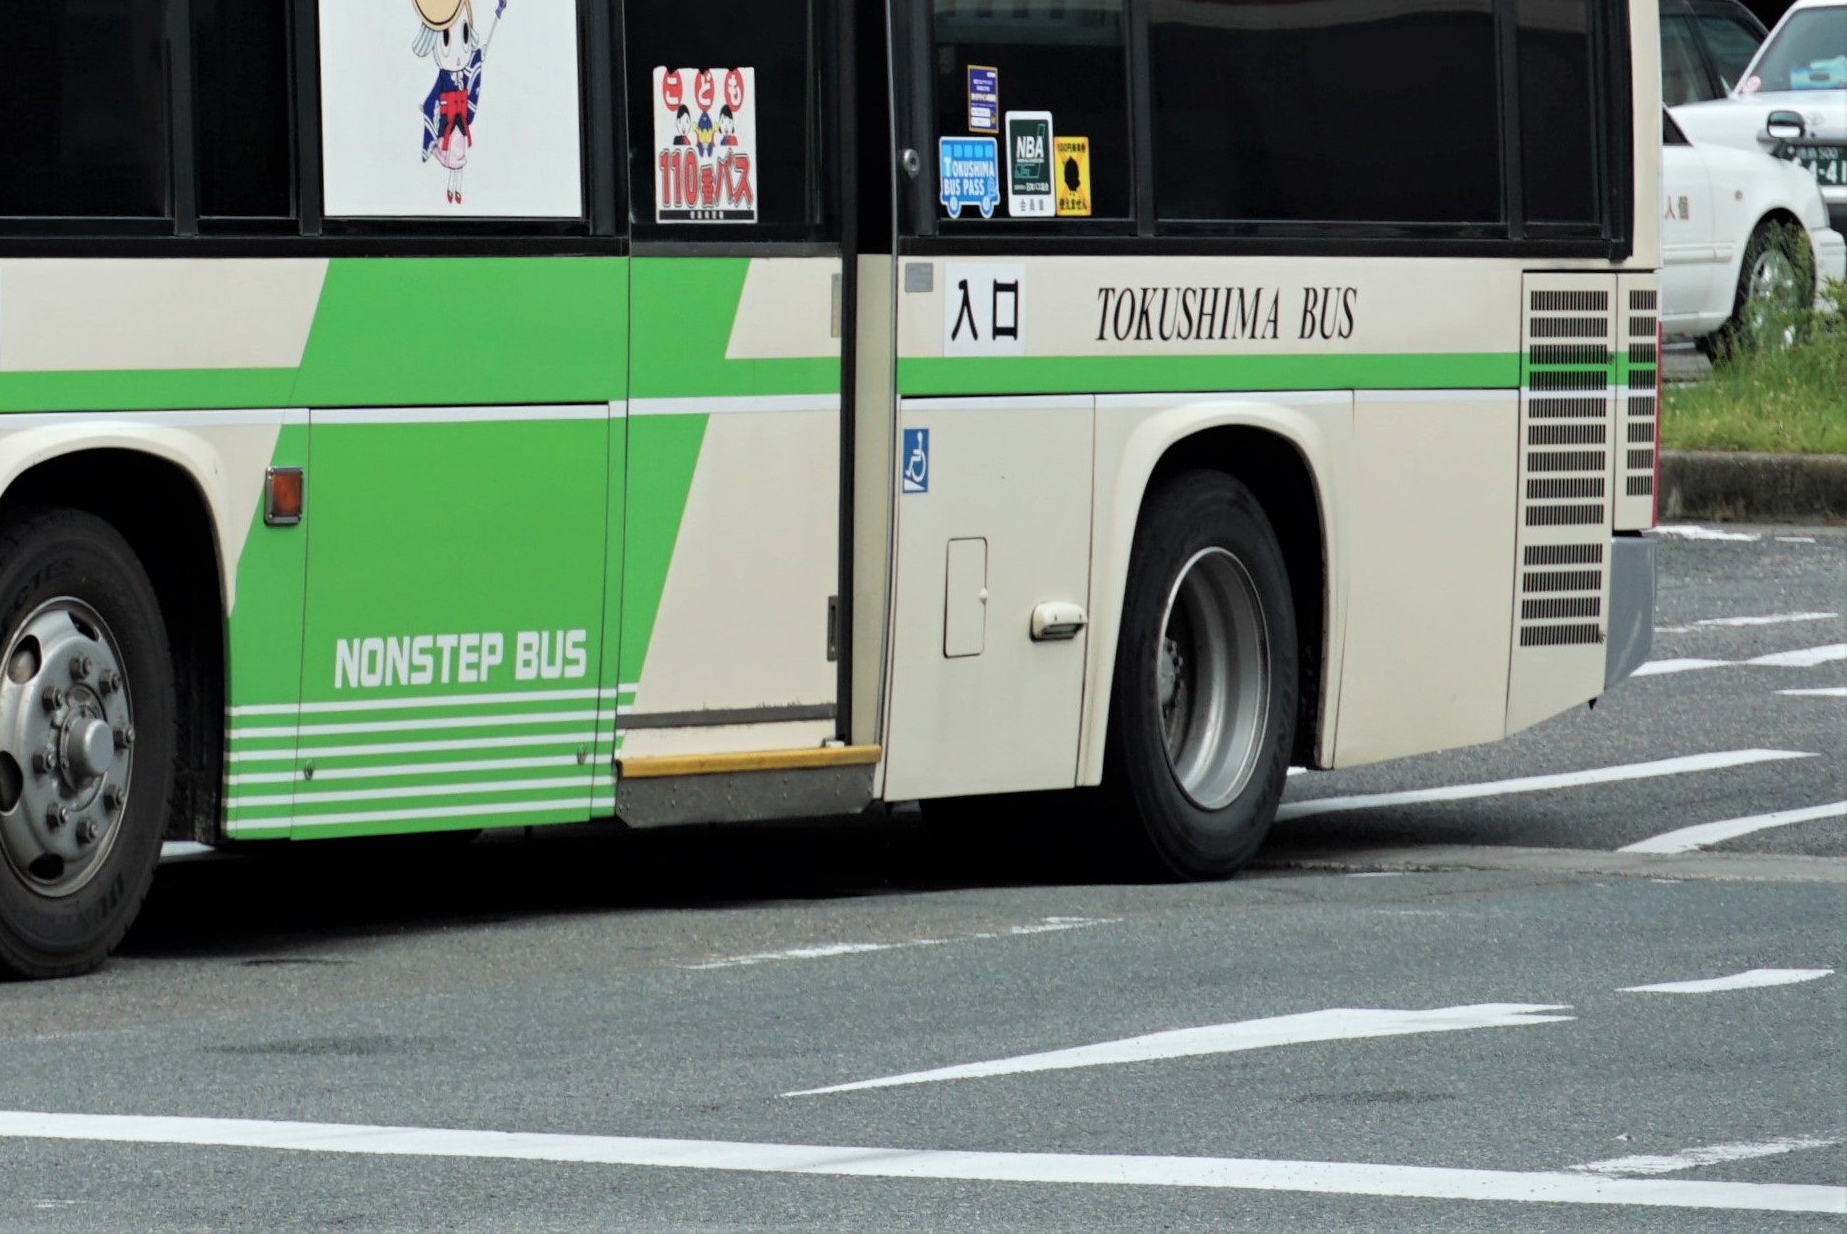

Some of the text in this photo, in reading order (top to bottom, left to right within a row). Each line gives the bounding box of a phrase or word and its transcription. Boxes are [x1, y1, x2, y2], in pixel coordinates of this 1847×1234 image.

[664, 72, 743, 107] こども
[1016, 135, 1045, 159] NBA
[944, 156, 996, 178] TOKUSHIMA
[943, 177, 986, 196] BUS PASS
[951, 278, 1020, 342] 入口
[1095, 286, 1358, 342] TOKUSHIMA BUS
[334, 629, 587, 689] NONSTEP BUS
